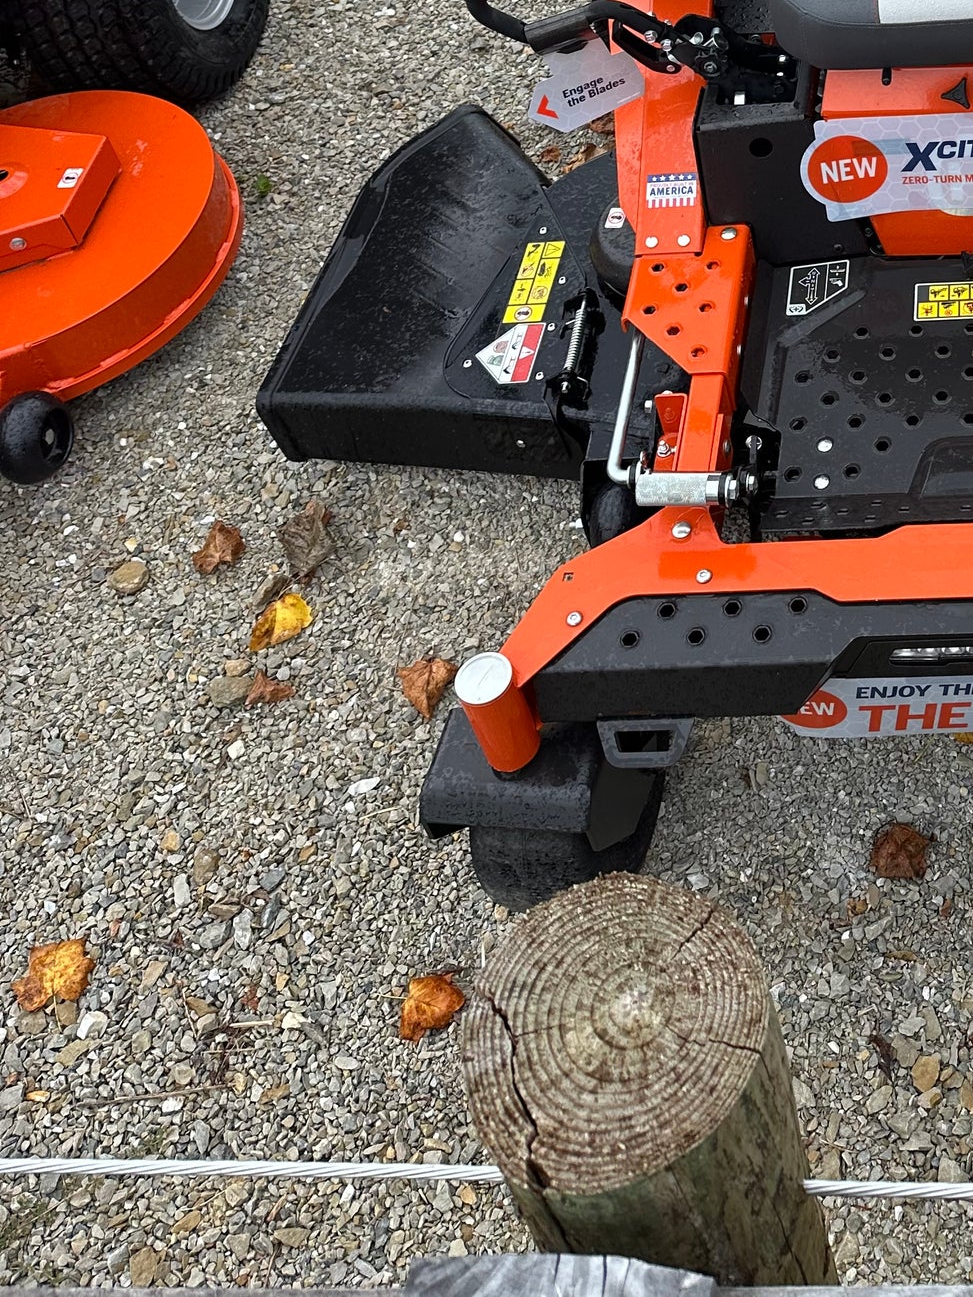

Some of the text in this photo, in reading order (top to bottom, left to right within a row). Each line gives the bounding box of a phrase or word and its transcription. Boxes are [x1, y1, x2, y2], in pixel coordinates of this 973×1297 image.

[562, 77, 604, 99] Engage
[567, 95, 586, 107] the
[588, 78, 626, 98] Blades
[820, 157, 877, 184] NEW
[902, 175, 963, 185] ZERO-TURN
[650, 186, 694, 196] AMERICA
[856, 685, 932, 699] ENJOY
[800, 702, 835, 716] EW
[858, 702, 972, 732] THE
